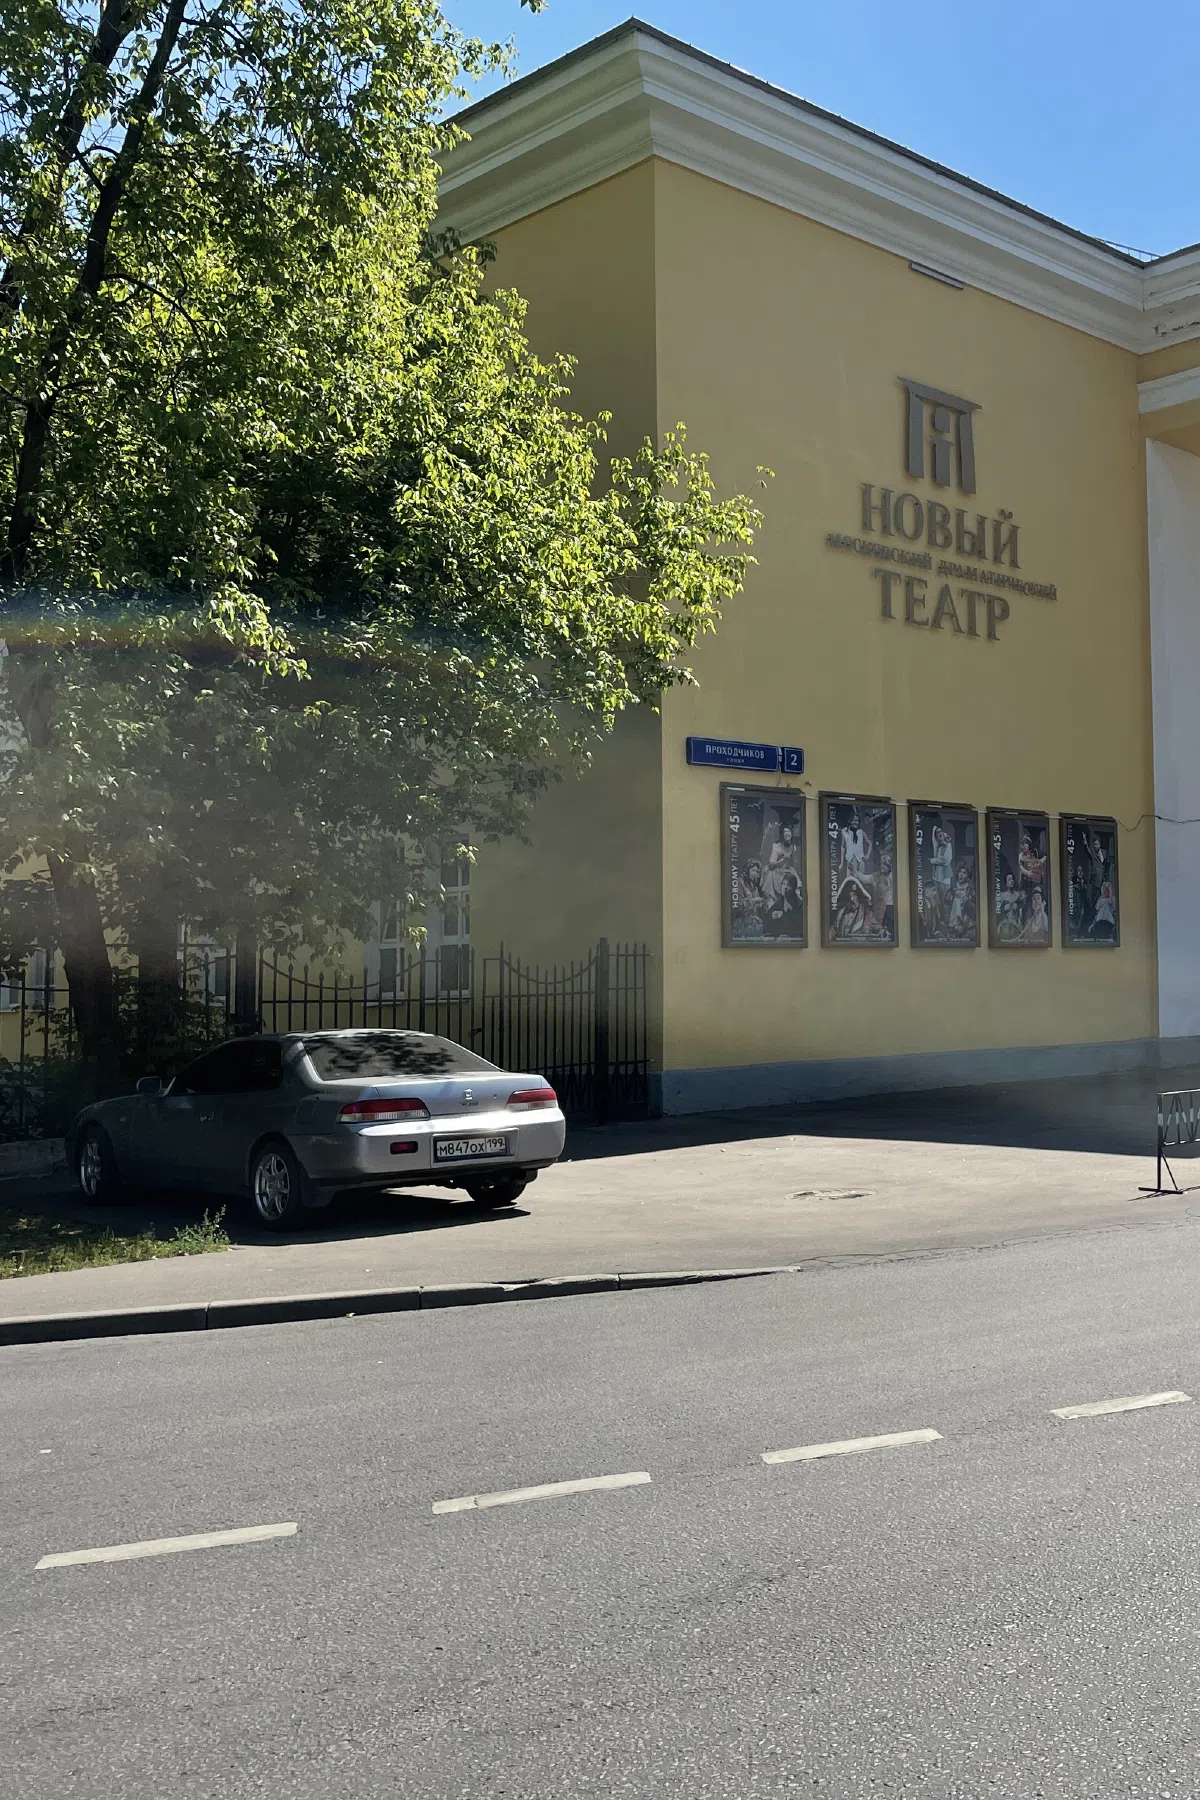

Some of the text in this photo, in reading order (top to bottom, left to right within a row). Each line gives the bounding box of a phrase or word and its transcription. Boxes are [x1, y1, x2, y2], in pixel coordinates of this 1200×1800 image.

[861, 482, 1022, 570] НОВЫЙ
[827, 532, 1058, 601] МОСКОВСКИЙ ДРАМАТИЧЕСКИЙ
[873, 567, 1011, 641] ТЕАТР
[705, 744, 765, 759] ПРОХОДЧИКОВ
[790, 753, 798, 766] 2
[730, 797, 738, 813] ЛЕТ
[829, 805, 837, 820] ЛЕТ
[729, 815, 740, 833] 45
[828, 822, 839, 839] 45
[916, 829, 924, 845] 45
[993, 834, 1002, 850] 45
[731, 834, 739, 862] ТЕАТРУ
[830, 841, 838, 867] ТЕАТРУ
[1067, 839, 1075, 854] 45
[486, 1137, 504, 1148] 199
